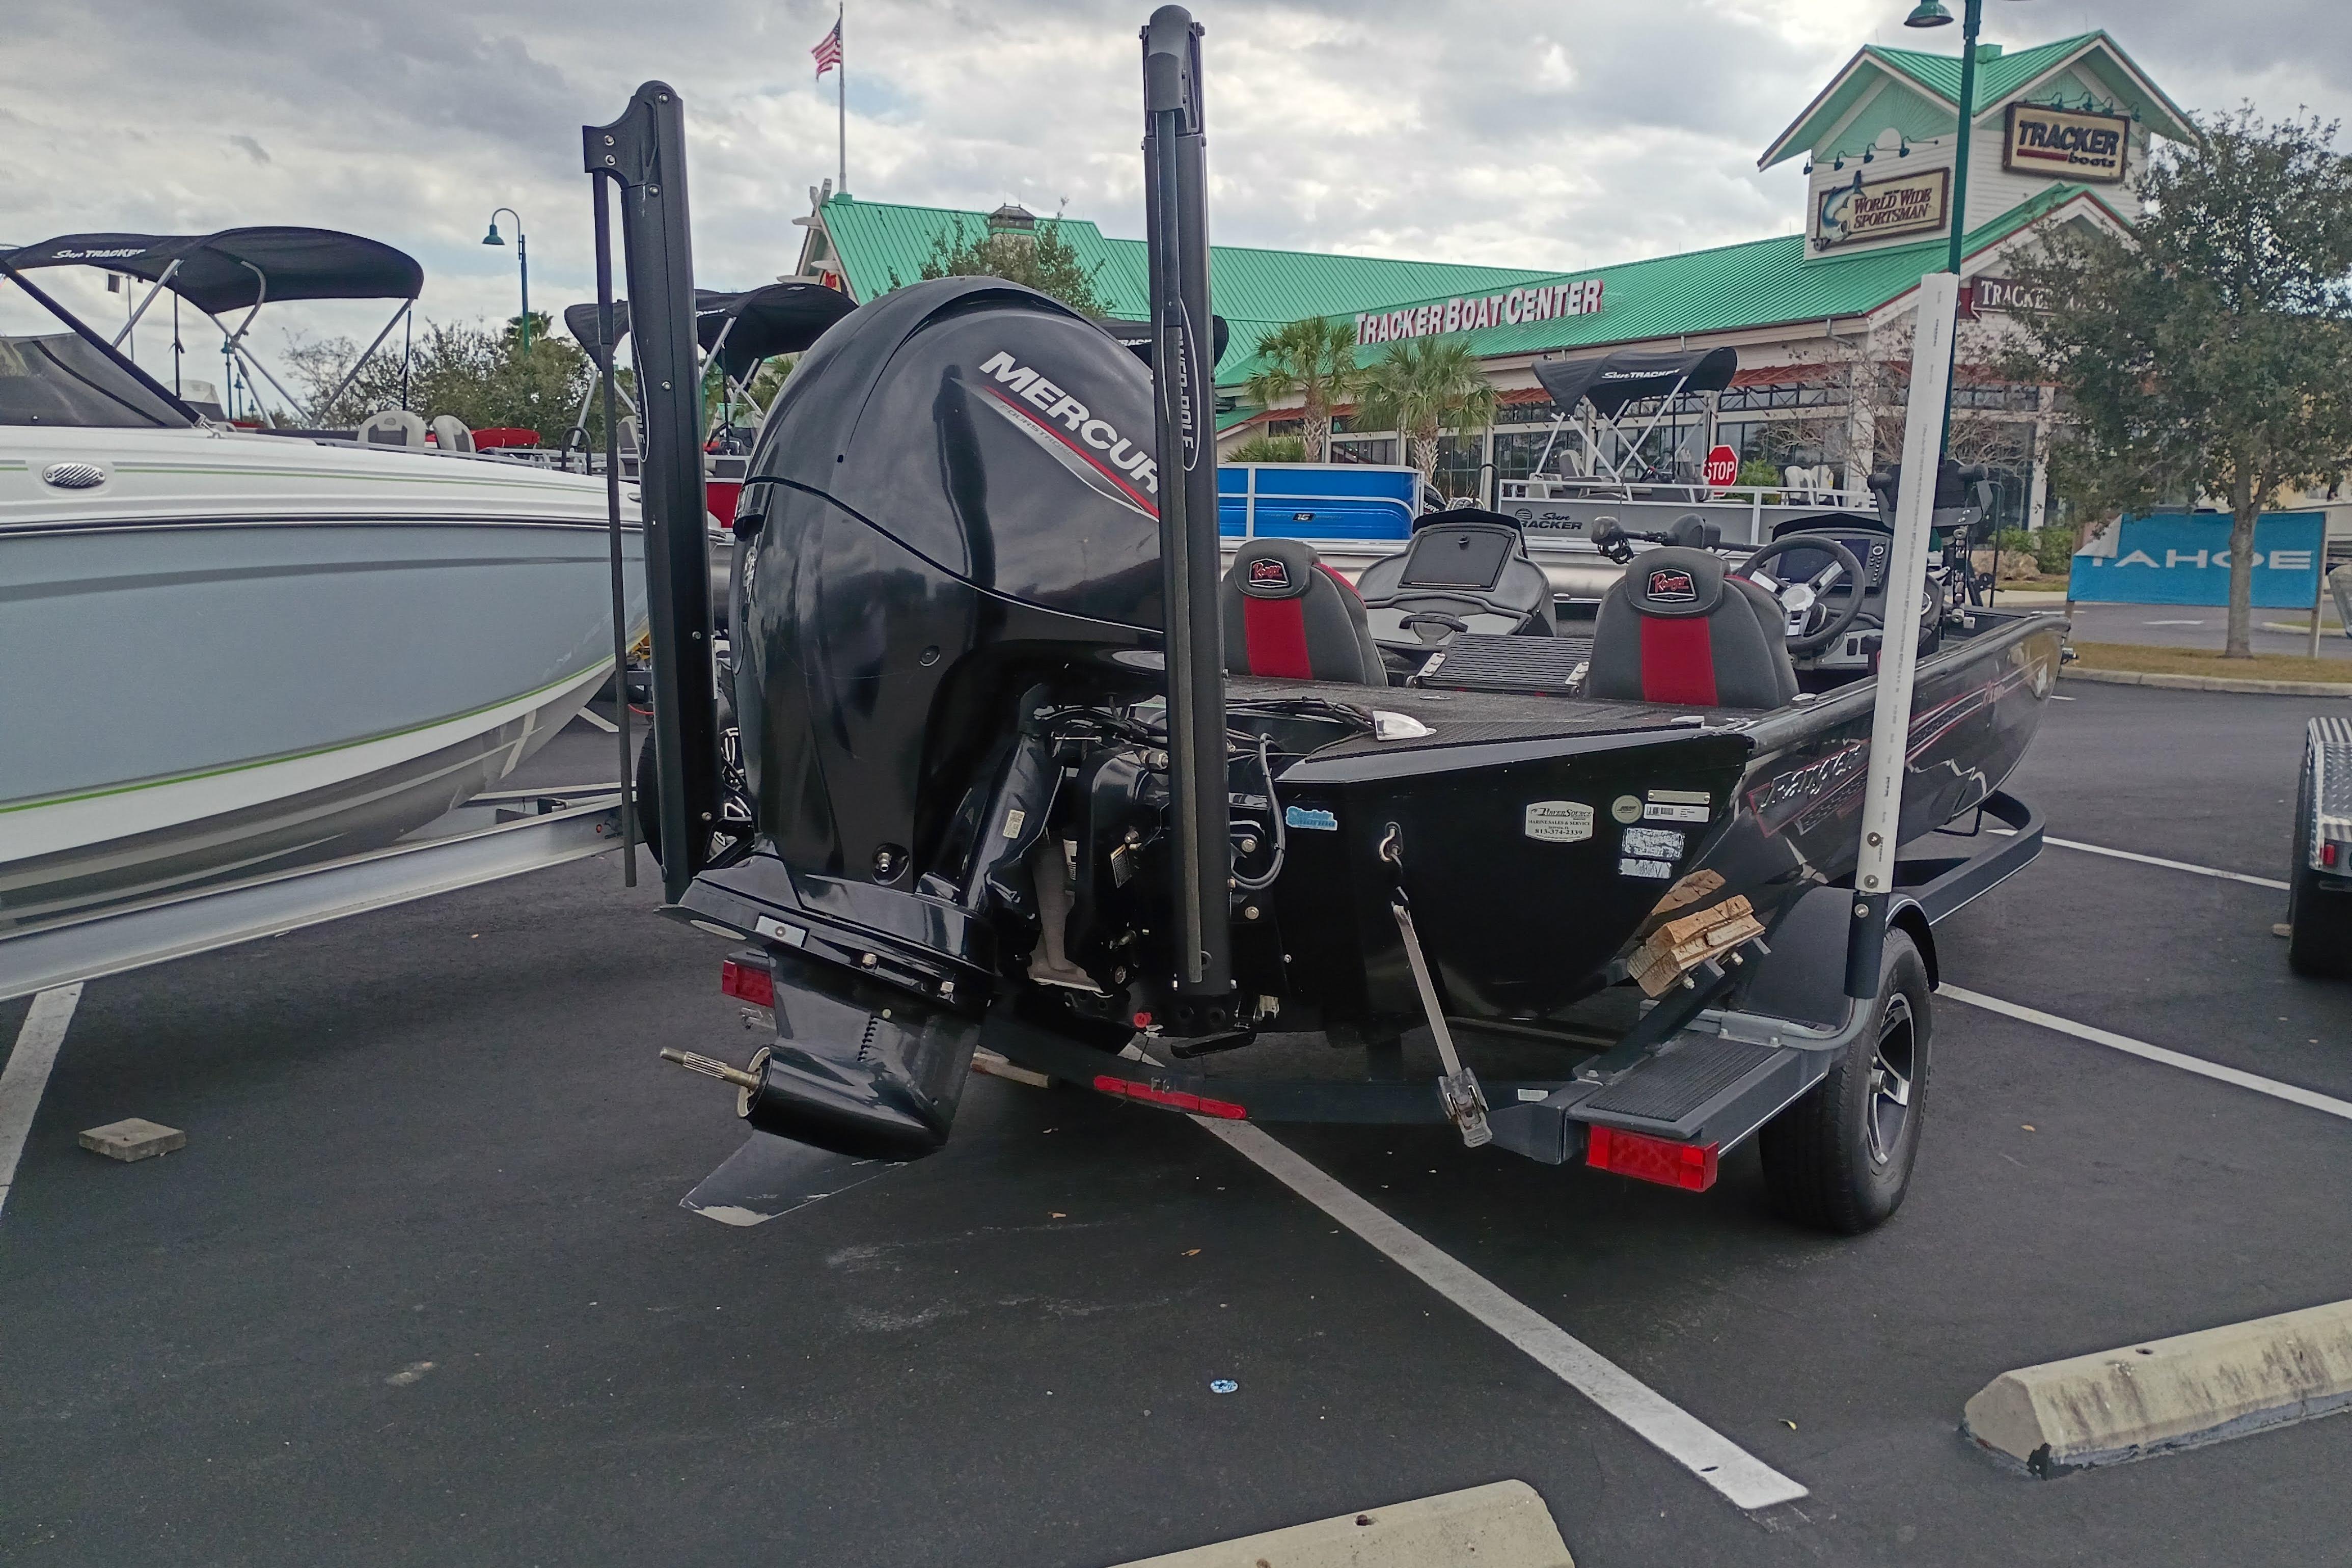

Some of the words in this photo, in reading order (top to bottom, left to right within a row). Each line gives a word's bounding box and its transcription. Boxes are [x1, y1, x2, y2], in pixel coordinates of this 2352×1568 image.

[2018, 120, 2120, 156] TRACKER
[1853, 203, 1929, 229] SPORTSMAN
[1854, 191, 1897, 215] WORLD
[1900, 187, 1933, 206] WIDE
[1981, 280, 2050, 309] TRACKE
[1355, 304, 1445, 345] TRACKER
[1445, 298, 1506, 333] BOAT
[1506, 279, 1604, 325] CENTER
[979, 351, 1158, 494] MERCUR
[999, 405, 1074, 457] FOURSTROKE
[1540, 512, 1570, 520] Sun
